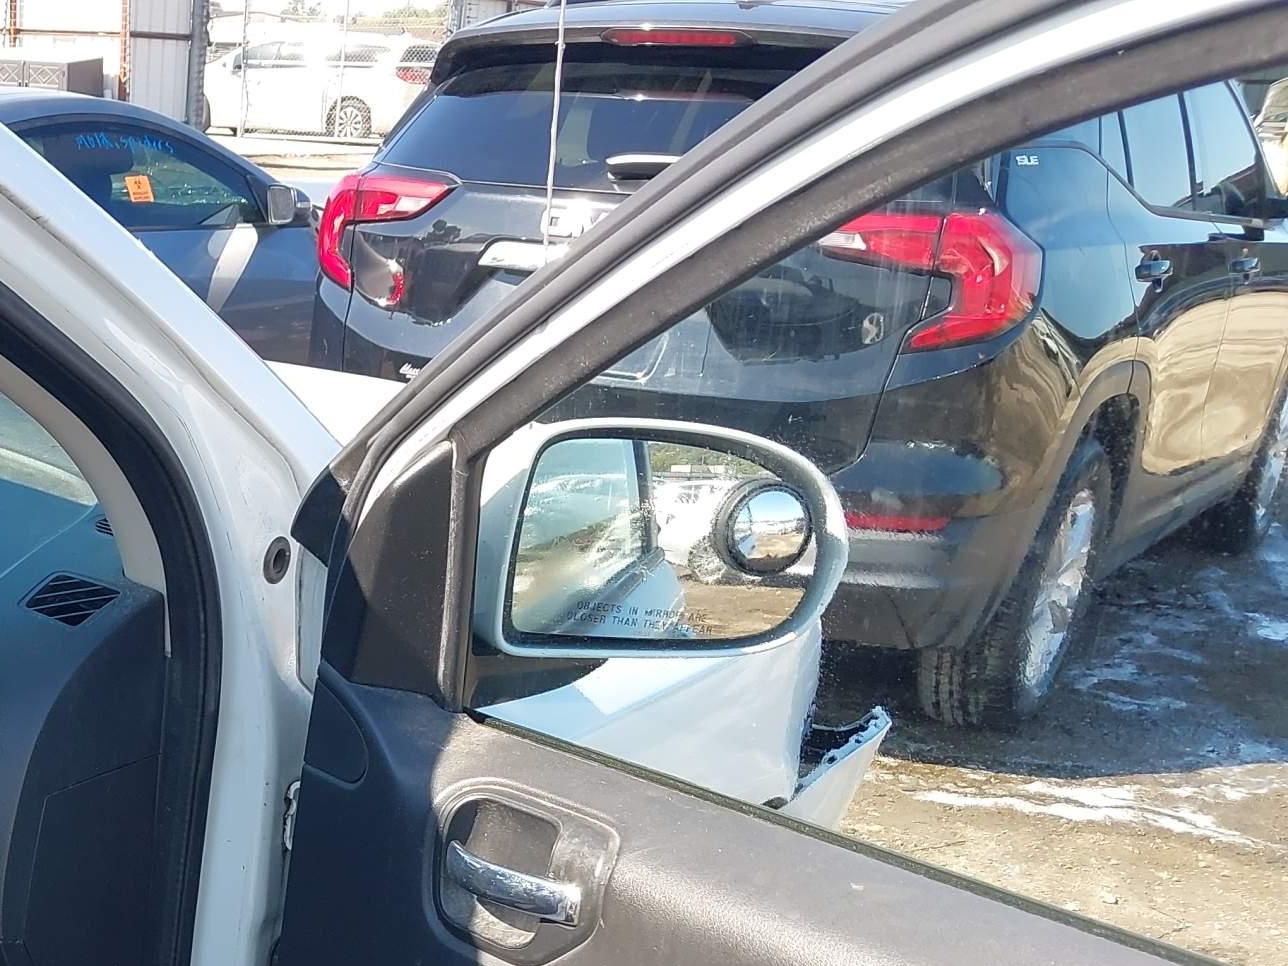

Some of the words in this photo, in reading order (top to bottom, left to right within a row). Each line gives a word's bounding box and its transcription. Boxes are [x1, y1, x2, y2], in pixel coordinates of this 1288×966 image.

[576, 600, 622, 614] OBJECTS
[628, 606, 639, 615] IN
[688, 611, 708, 622] ARE
[612, 615, 638, 627] THAN
[643, 619, 669, 631] THEY
